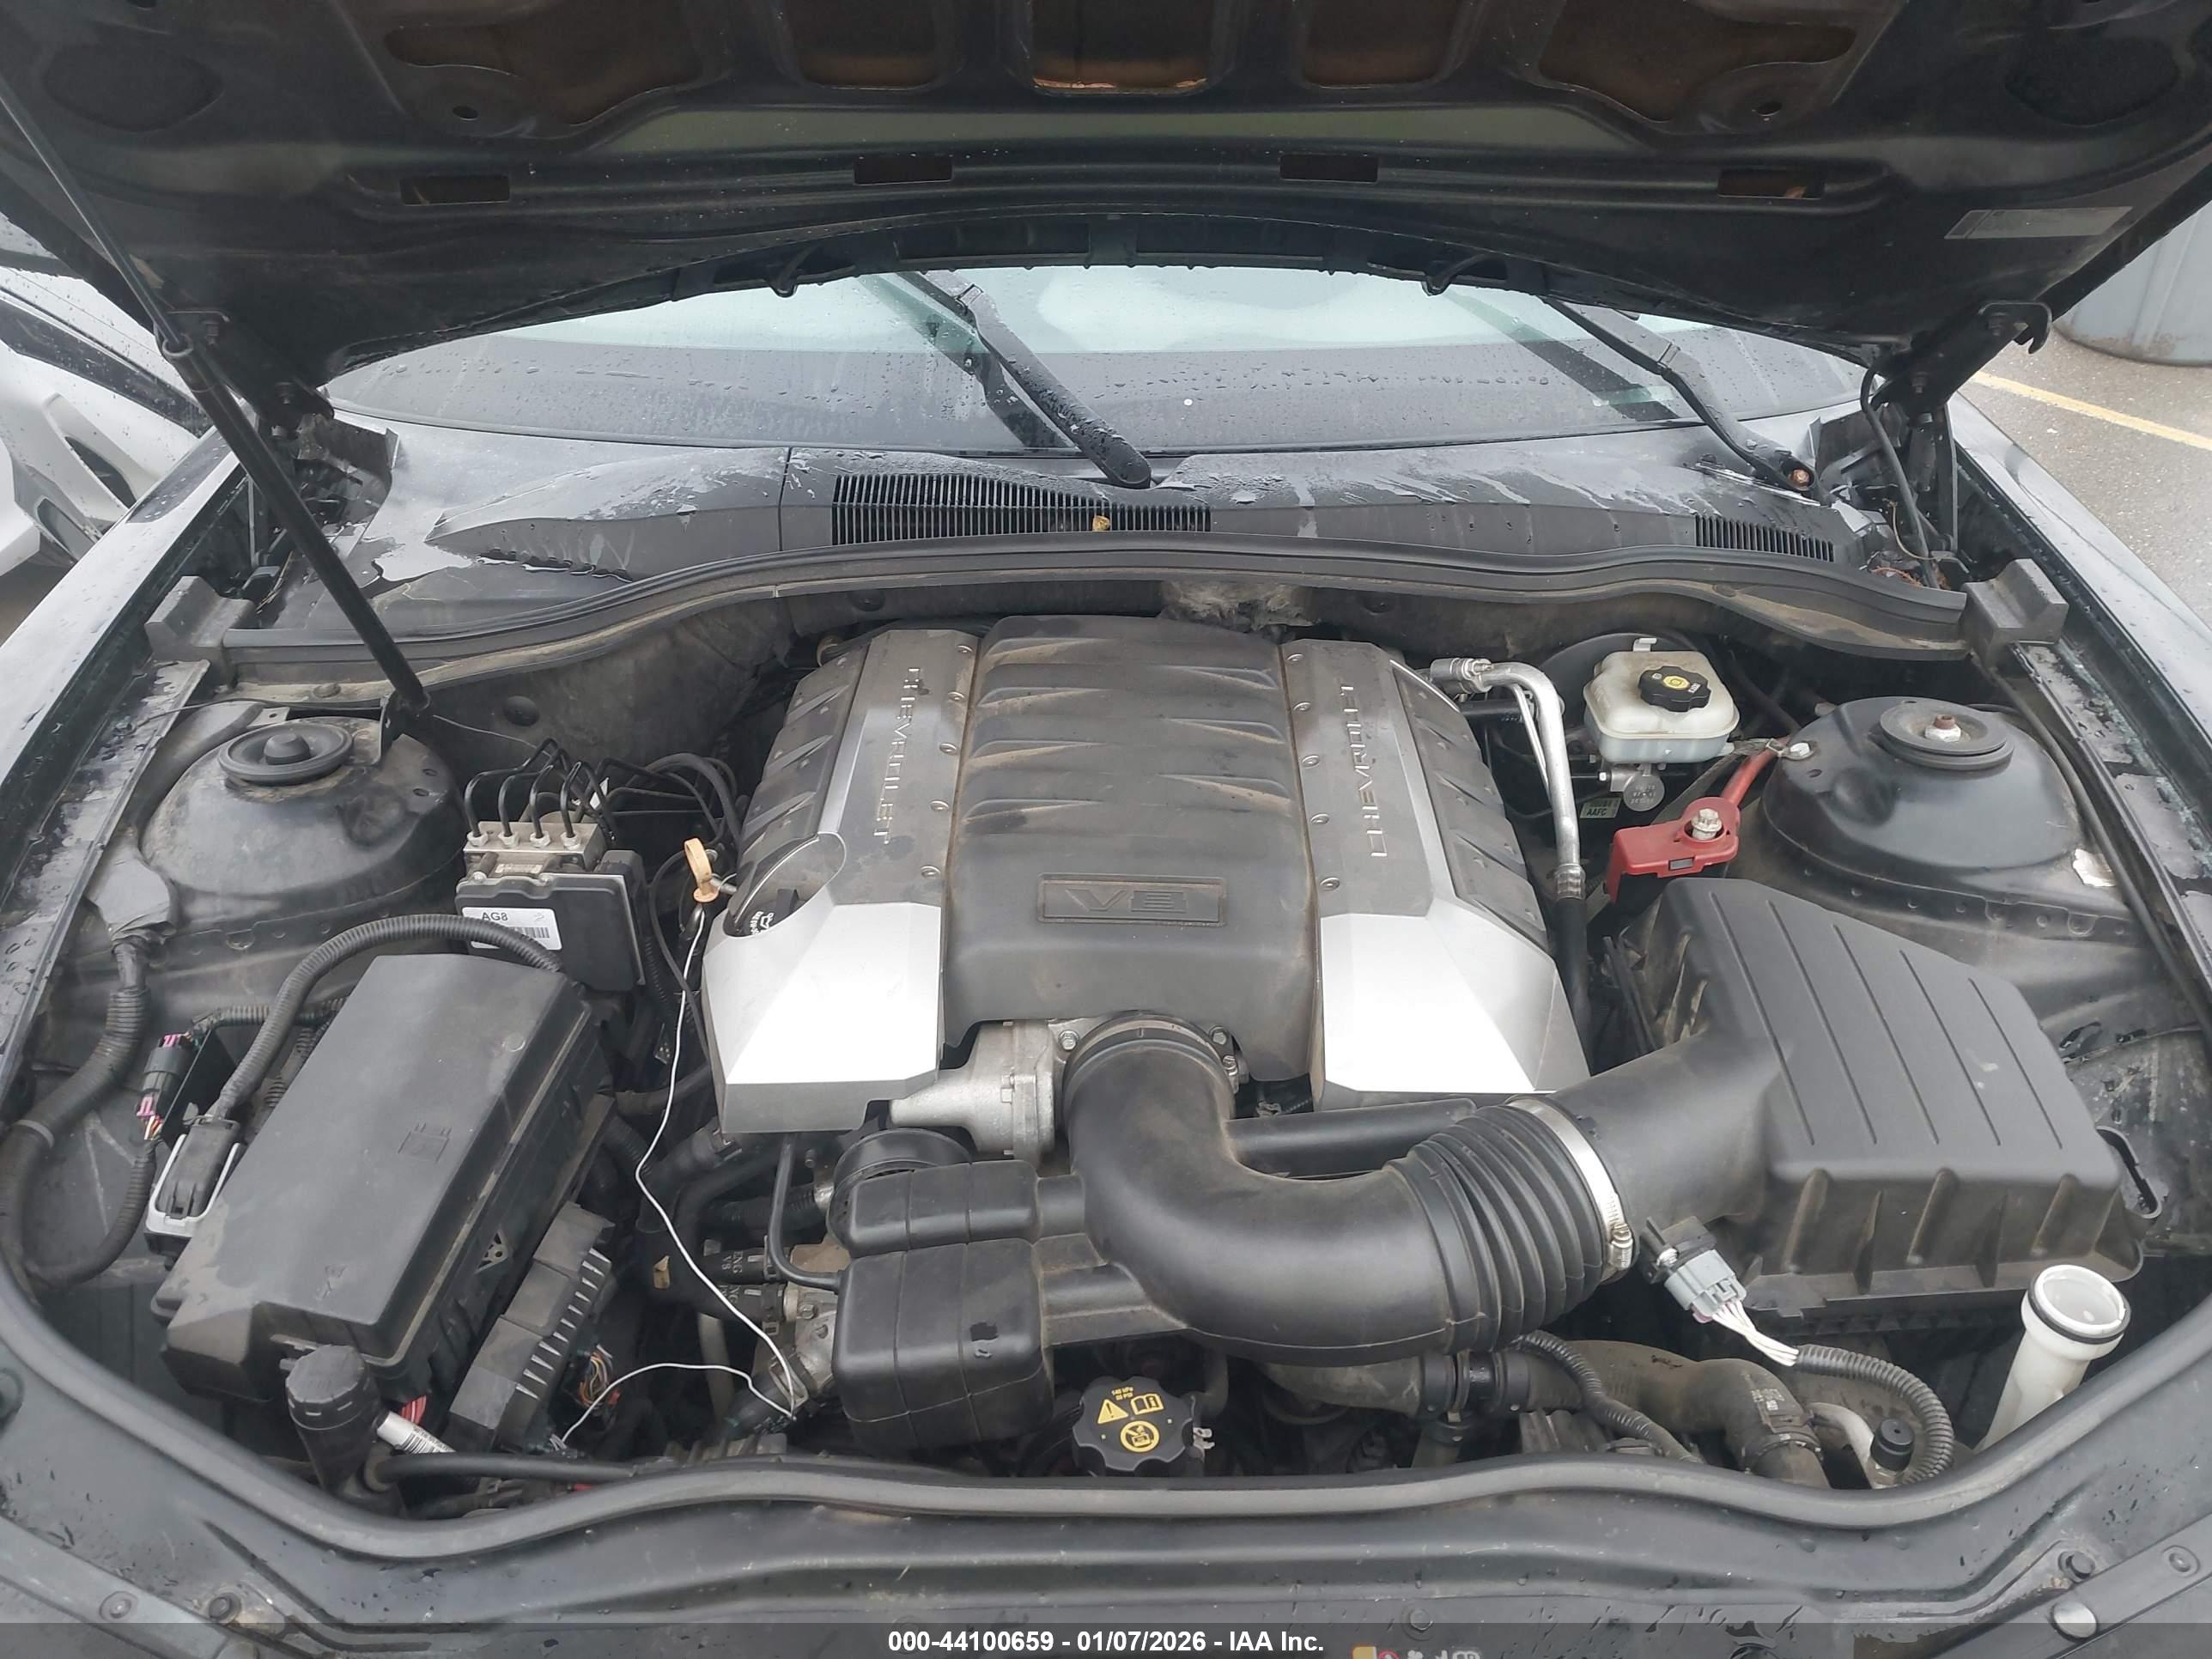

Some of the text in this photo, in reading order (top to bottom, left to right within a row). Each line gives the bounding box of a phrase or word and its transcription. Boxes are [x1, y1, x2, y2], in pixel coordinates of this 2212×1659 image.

[873, 667, 921, 845] CHEVROLET
[1340, 682, 1388, 858] CHEVROLET
[1064, 888, 1188, 914] V8
